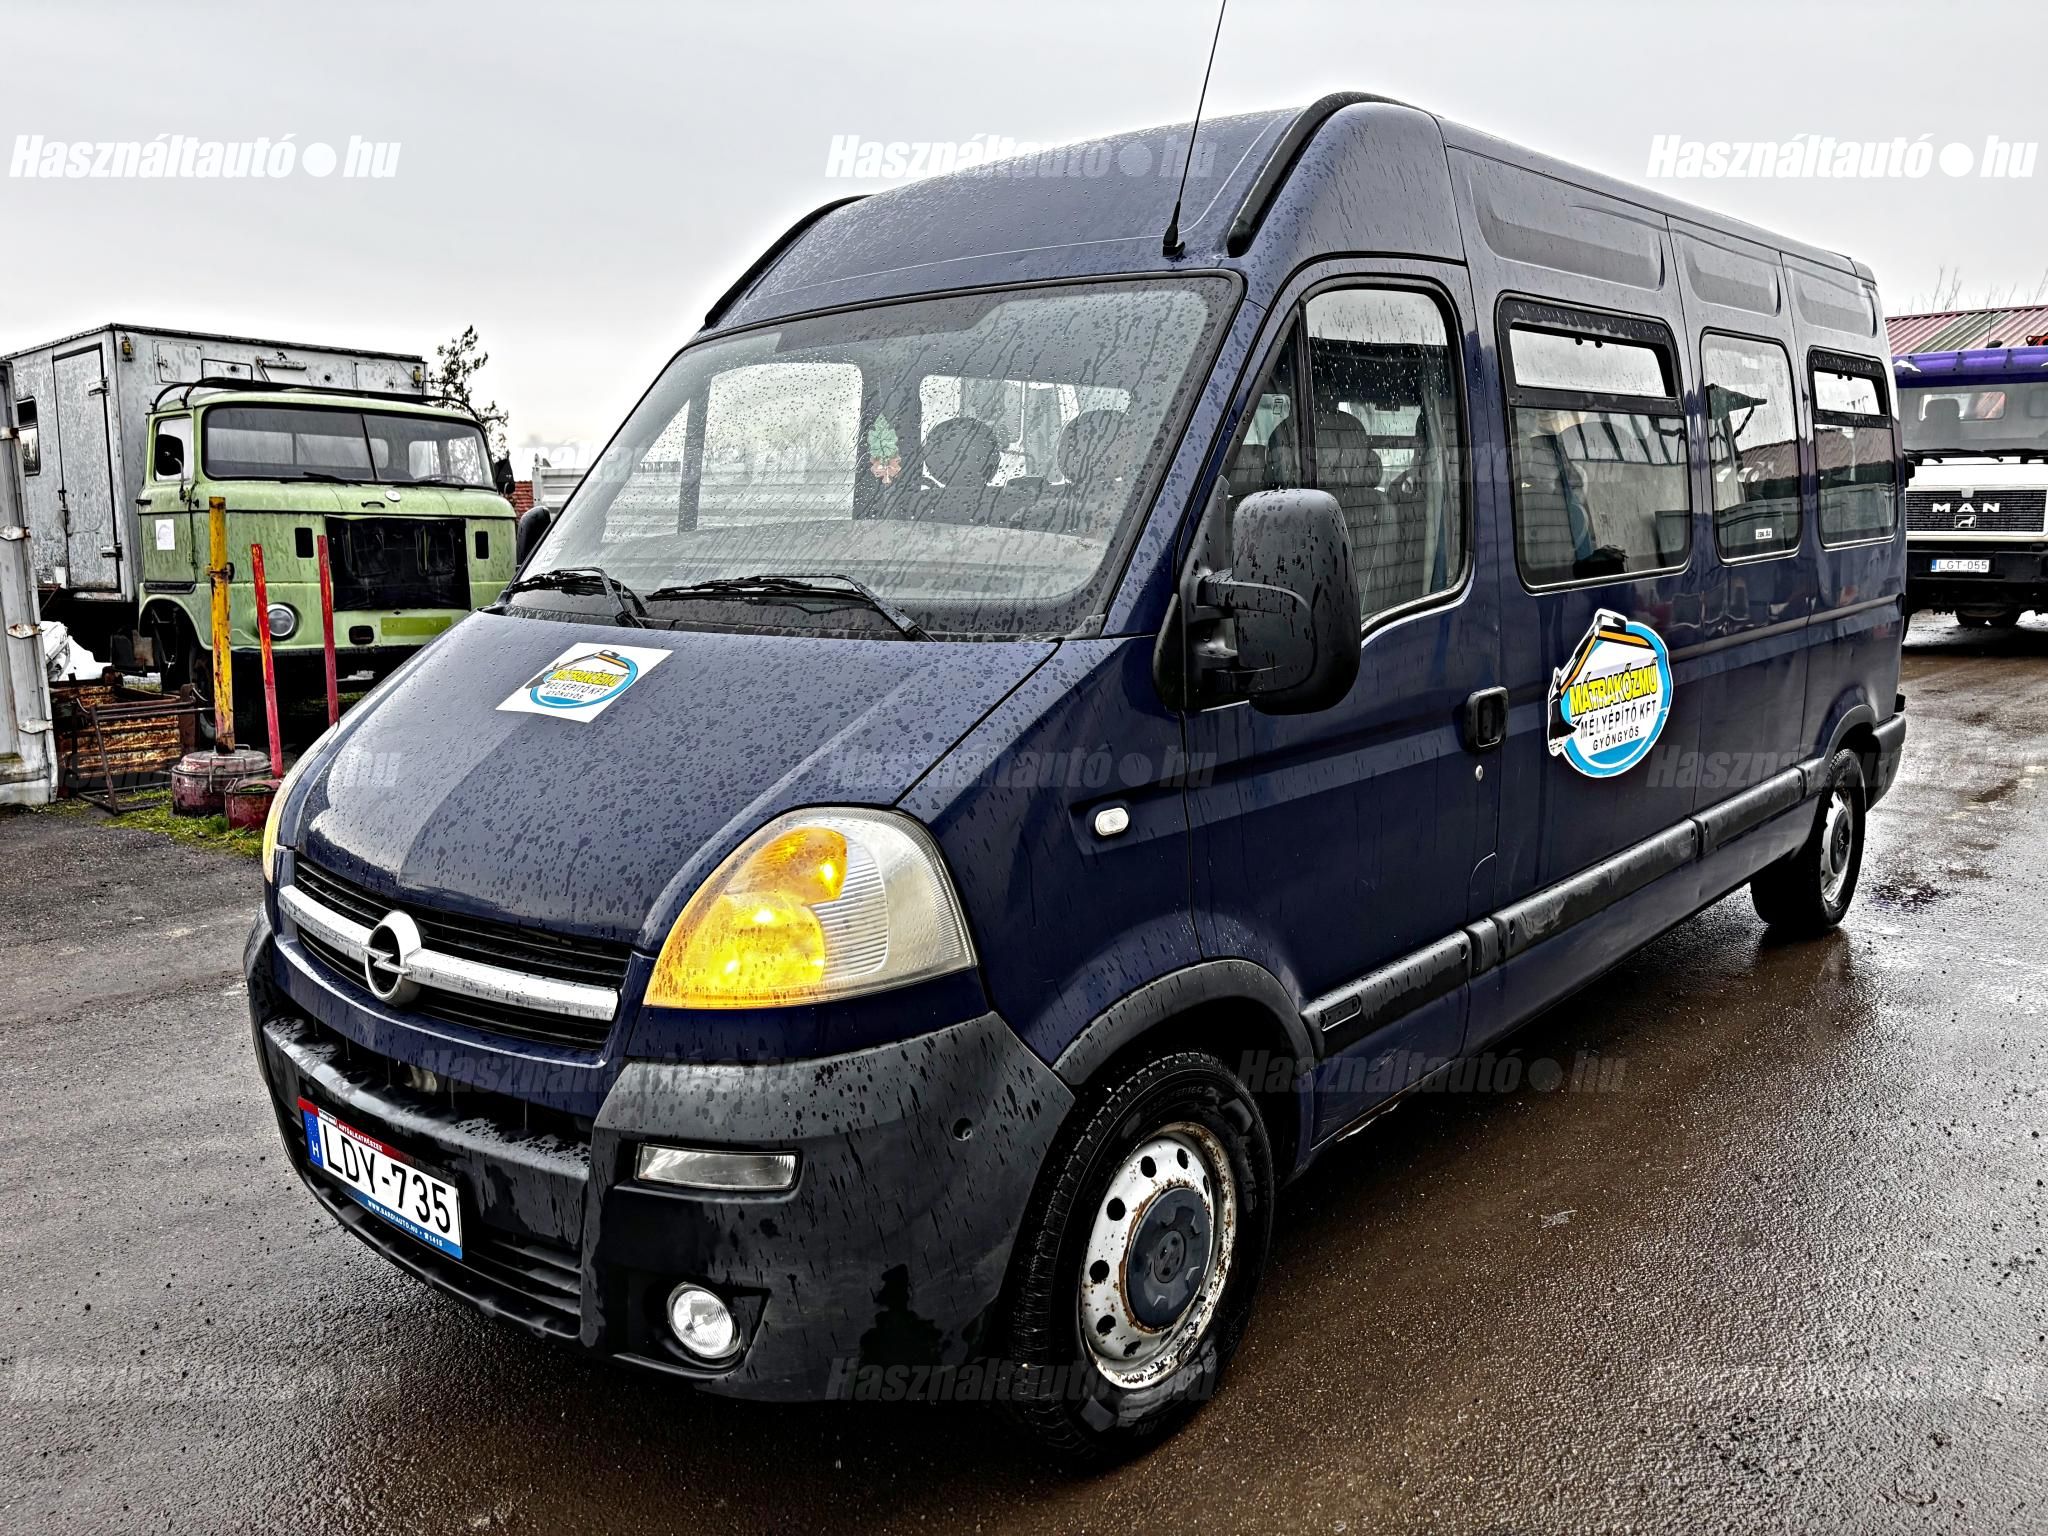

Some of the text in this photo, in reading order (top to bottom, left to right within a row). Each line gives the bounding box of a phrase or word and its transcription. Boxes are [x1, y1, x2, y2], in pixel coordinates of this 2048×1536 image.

[1932, 502, 2000, 513] MAN
[1939, 560, 1987, 570] LGT-055
[1592, 726, 1639, 751] GYÖNGYÖS
[311, 1140, 320, 1158] H
[323, 1124, 451, 1234] LDY-735
